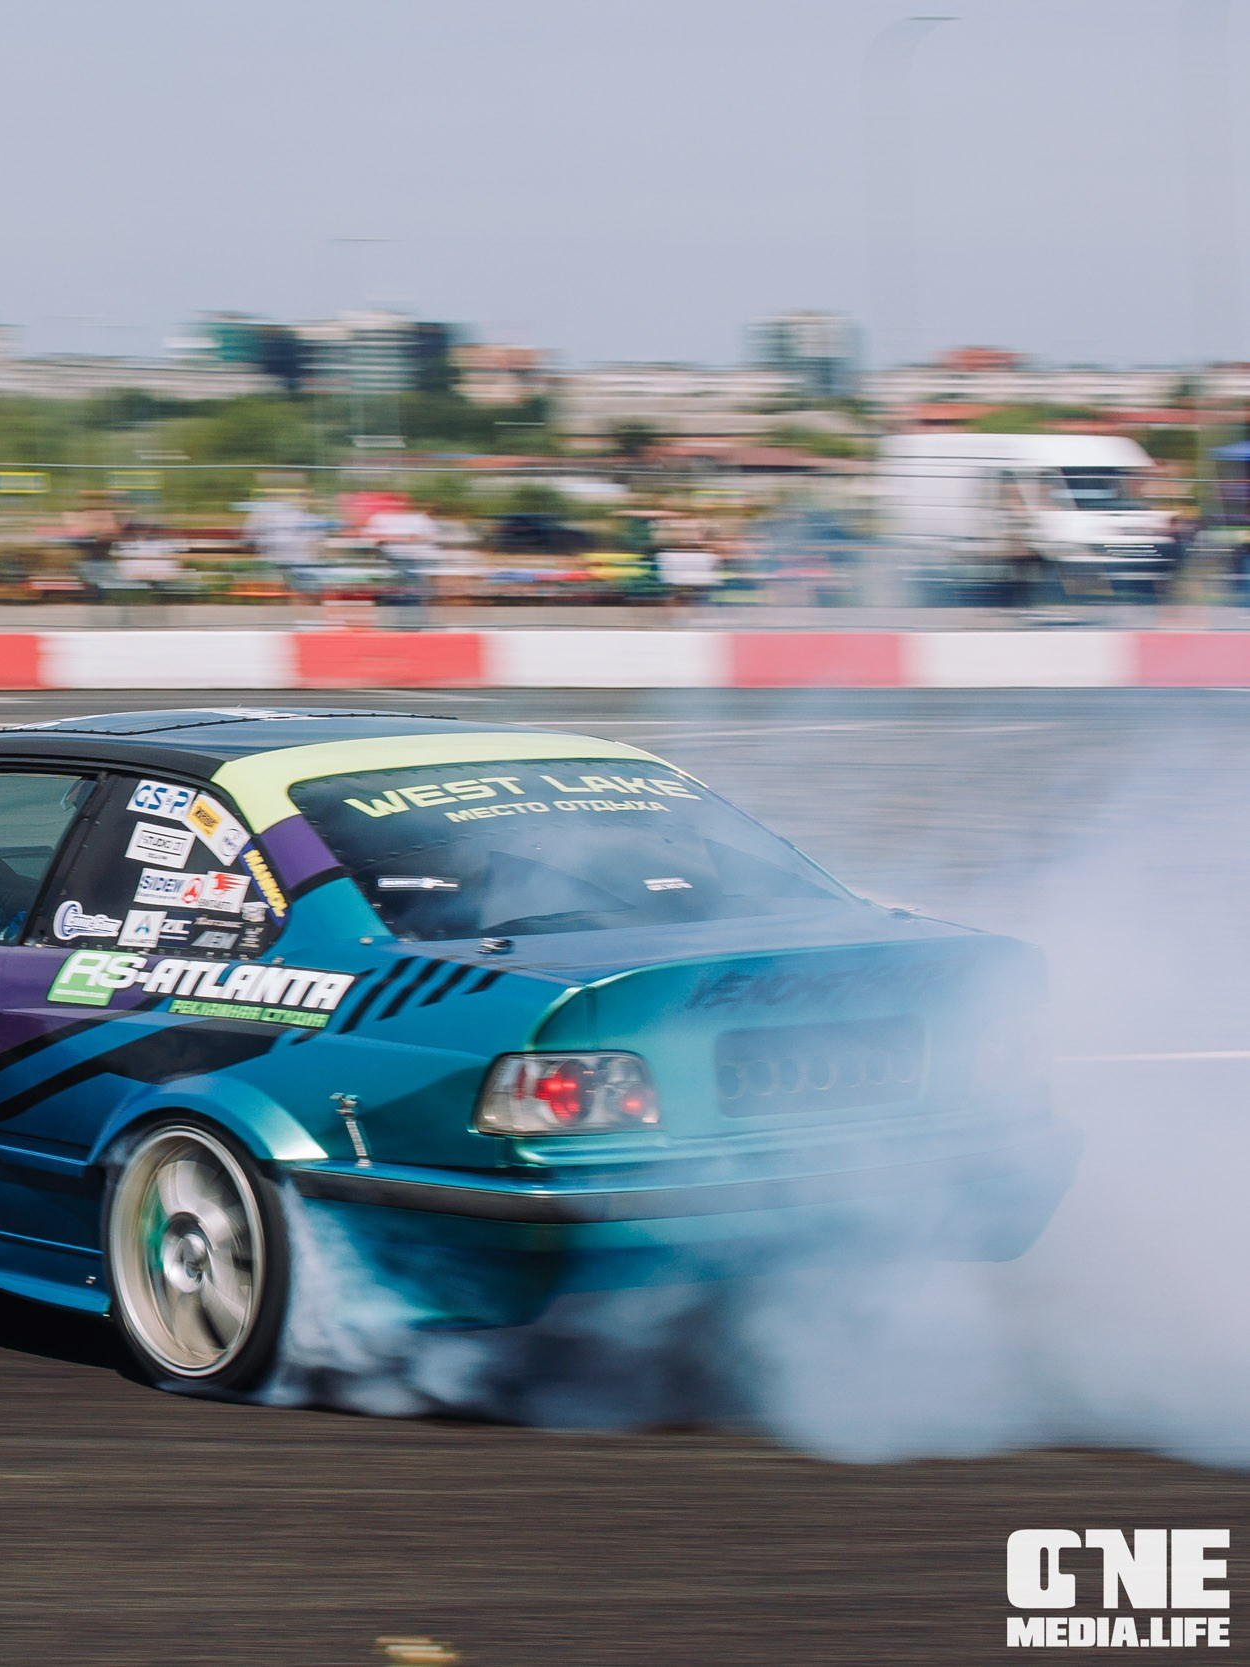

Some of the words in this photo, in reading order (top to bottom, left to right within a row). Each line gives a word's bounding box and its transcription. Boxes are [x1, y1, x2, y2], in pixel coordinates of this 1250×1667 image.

[344, 777, 526, 818] WEST
[540, 775, 703, 801] LAKE
[445, 801, 550, 823] МЕСТО
[553, 800, 671, 813] ОТДЫХА
[59, 952, 355, 1011] AS-ATLANTA
